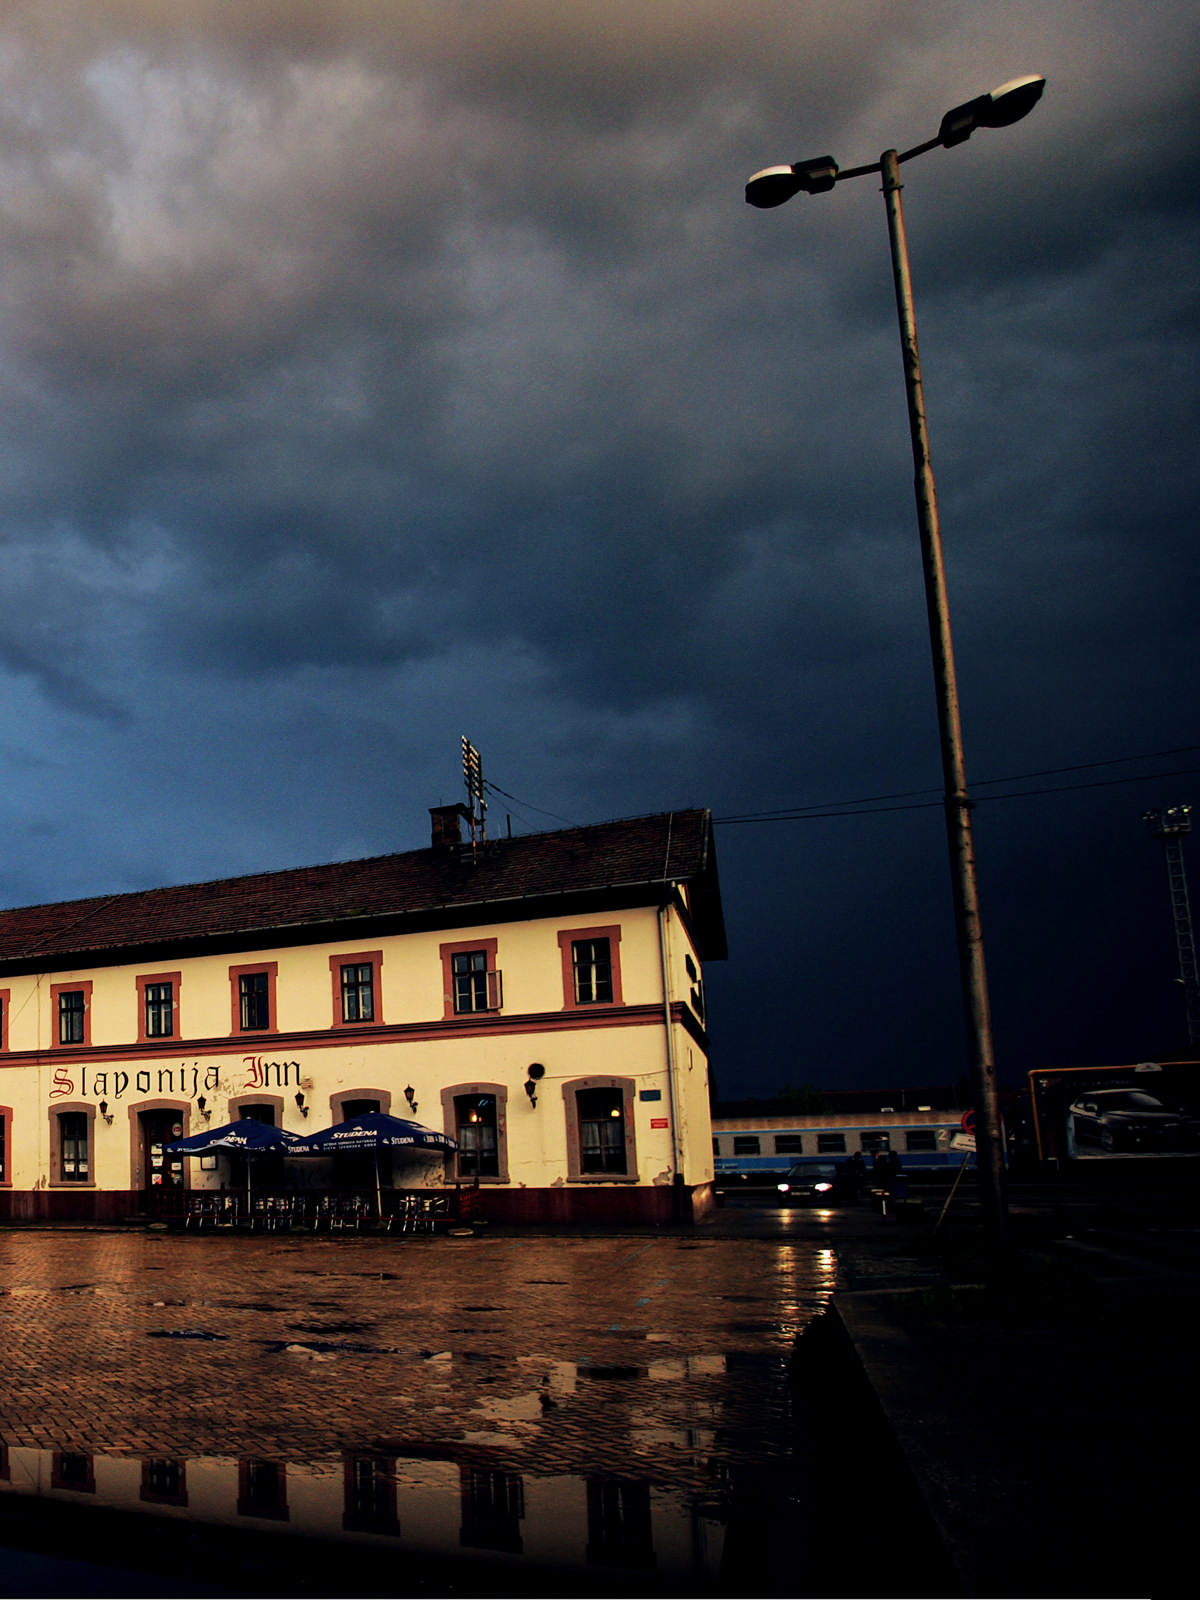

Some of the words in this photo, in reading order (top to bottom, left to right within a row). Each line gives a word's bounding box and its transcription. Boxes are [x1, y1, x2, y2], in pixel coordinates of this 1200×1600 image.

[242, 1056, 302, 1089] Inn
[331, 1130, 378, 1139] STUDENA
[938, 1128, 946, 1140] 2
